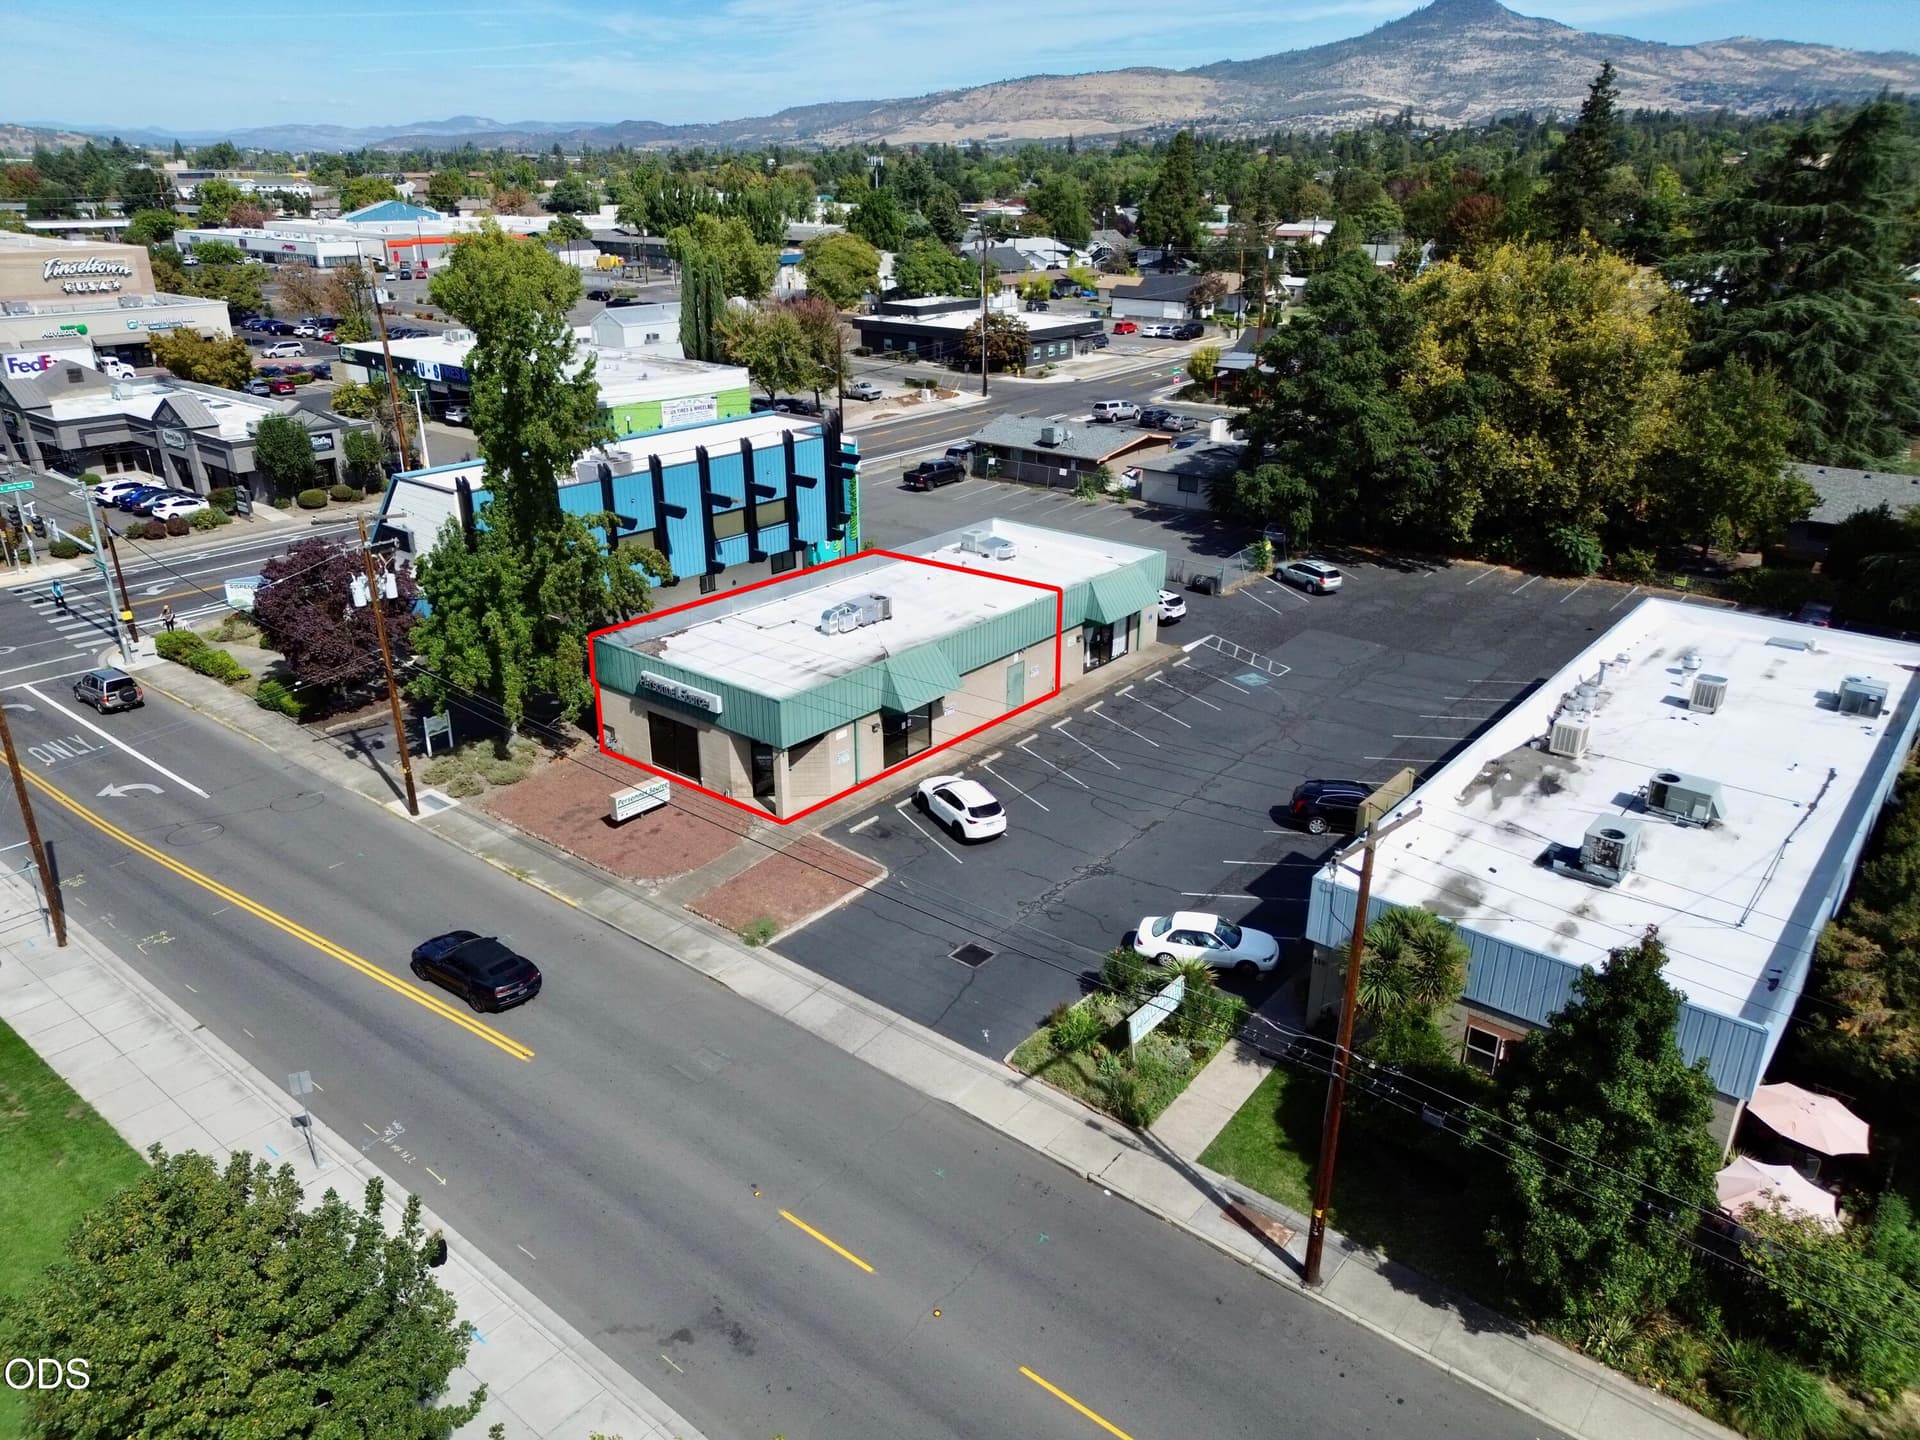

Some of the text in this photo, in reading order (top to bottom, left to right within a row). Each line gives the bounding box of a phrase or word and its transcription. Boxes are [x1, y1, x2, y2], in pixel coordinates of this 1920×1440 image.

[44, 256, 133, 280] Tinseltown
[75, 280, 110, 293] USA
[7, 354, 58, 374] FedE
[640, 674, 710, 710] Personnel Source
[28, 734, 96, 763] ONLY
[617, 782, 669, 806] Personnel Source
